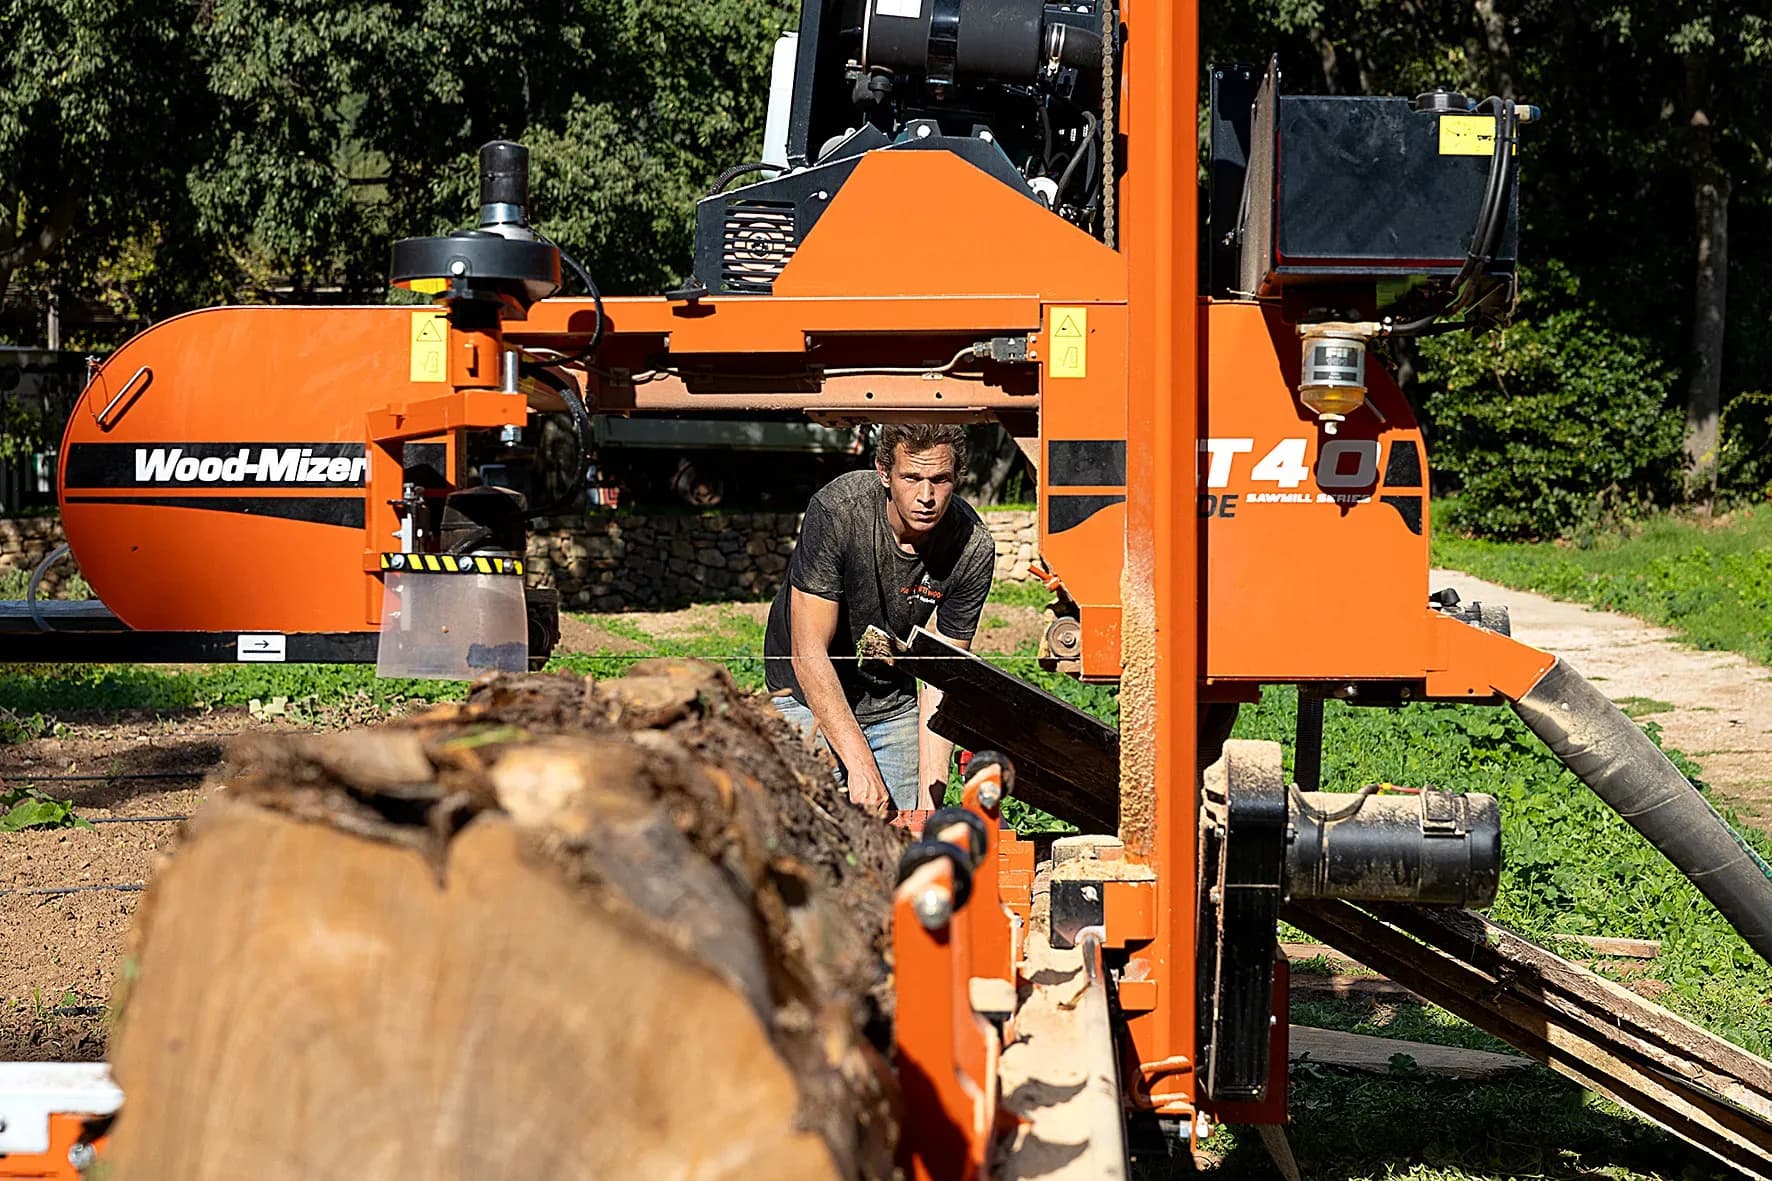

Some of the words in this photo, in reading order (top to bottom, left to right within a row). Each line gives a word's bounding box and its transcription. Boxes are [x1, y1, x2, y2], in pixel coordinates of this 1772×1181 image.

[135, 448, 368, 482] Wood-Mizer
[1246, 493, 1313, 503] SAWMILL
[1316, 493, 1372, 503] SERIES
